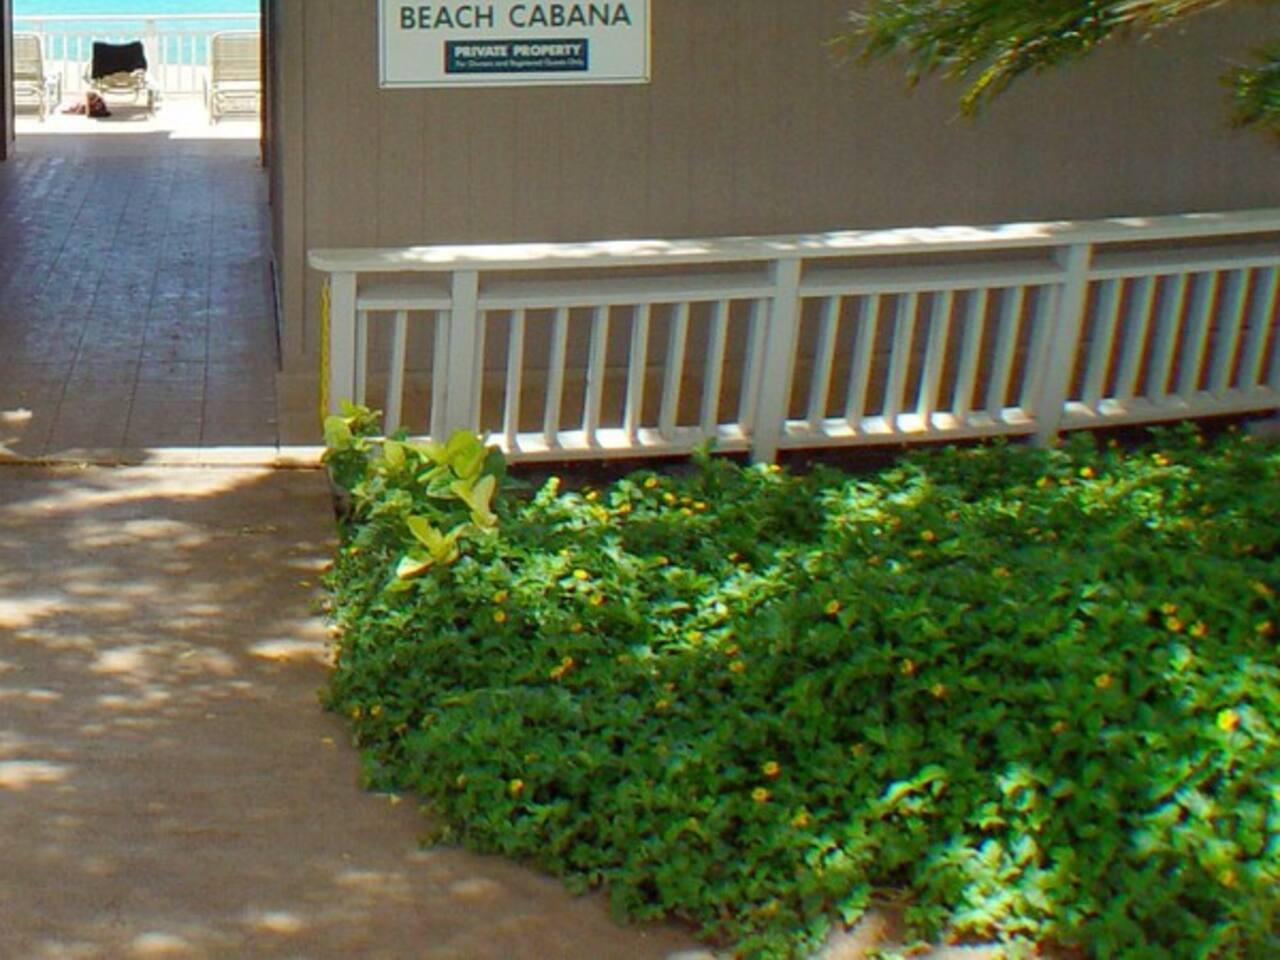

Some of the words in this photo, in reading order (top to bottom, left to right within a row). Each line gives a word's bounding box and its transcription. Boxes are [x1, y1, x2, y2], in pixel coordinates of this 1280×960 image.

[400, 5, 494, 29] BEACH
[508, 3, 632, 27] CABANA
[454, 46, 508, 58] PRIVATE
[513, 44, 582, 56] PROPERTY
